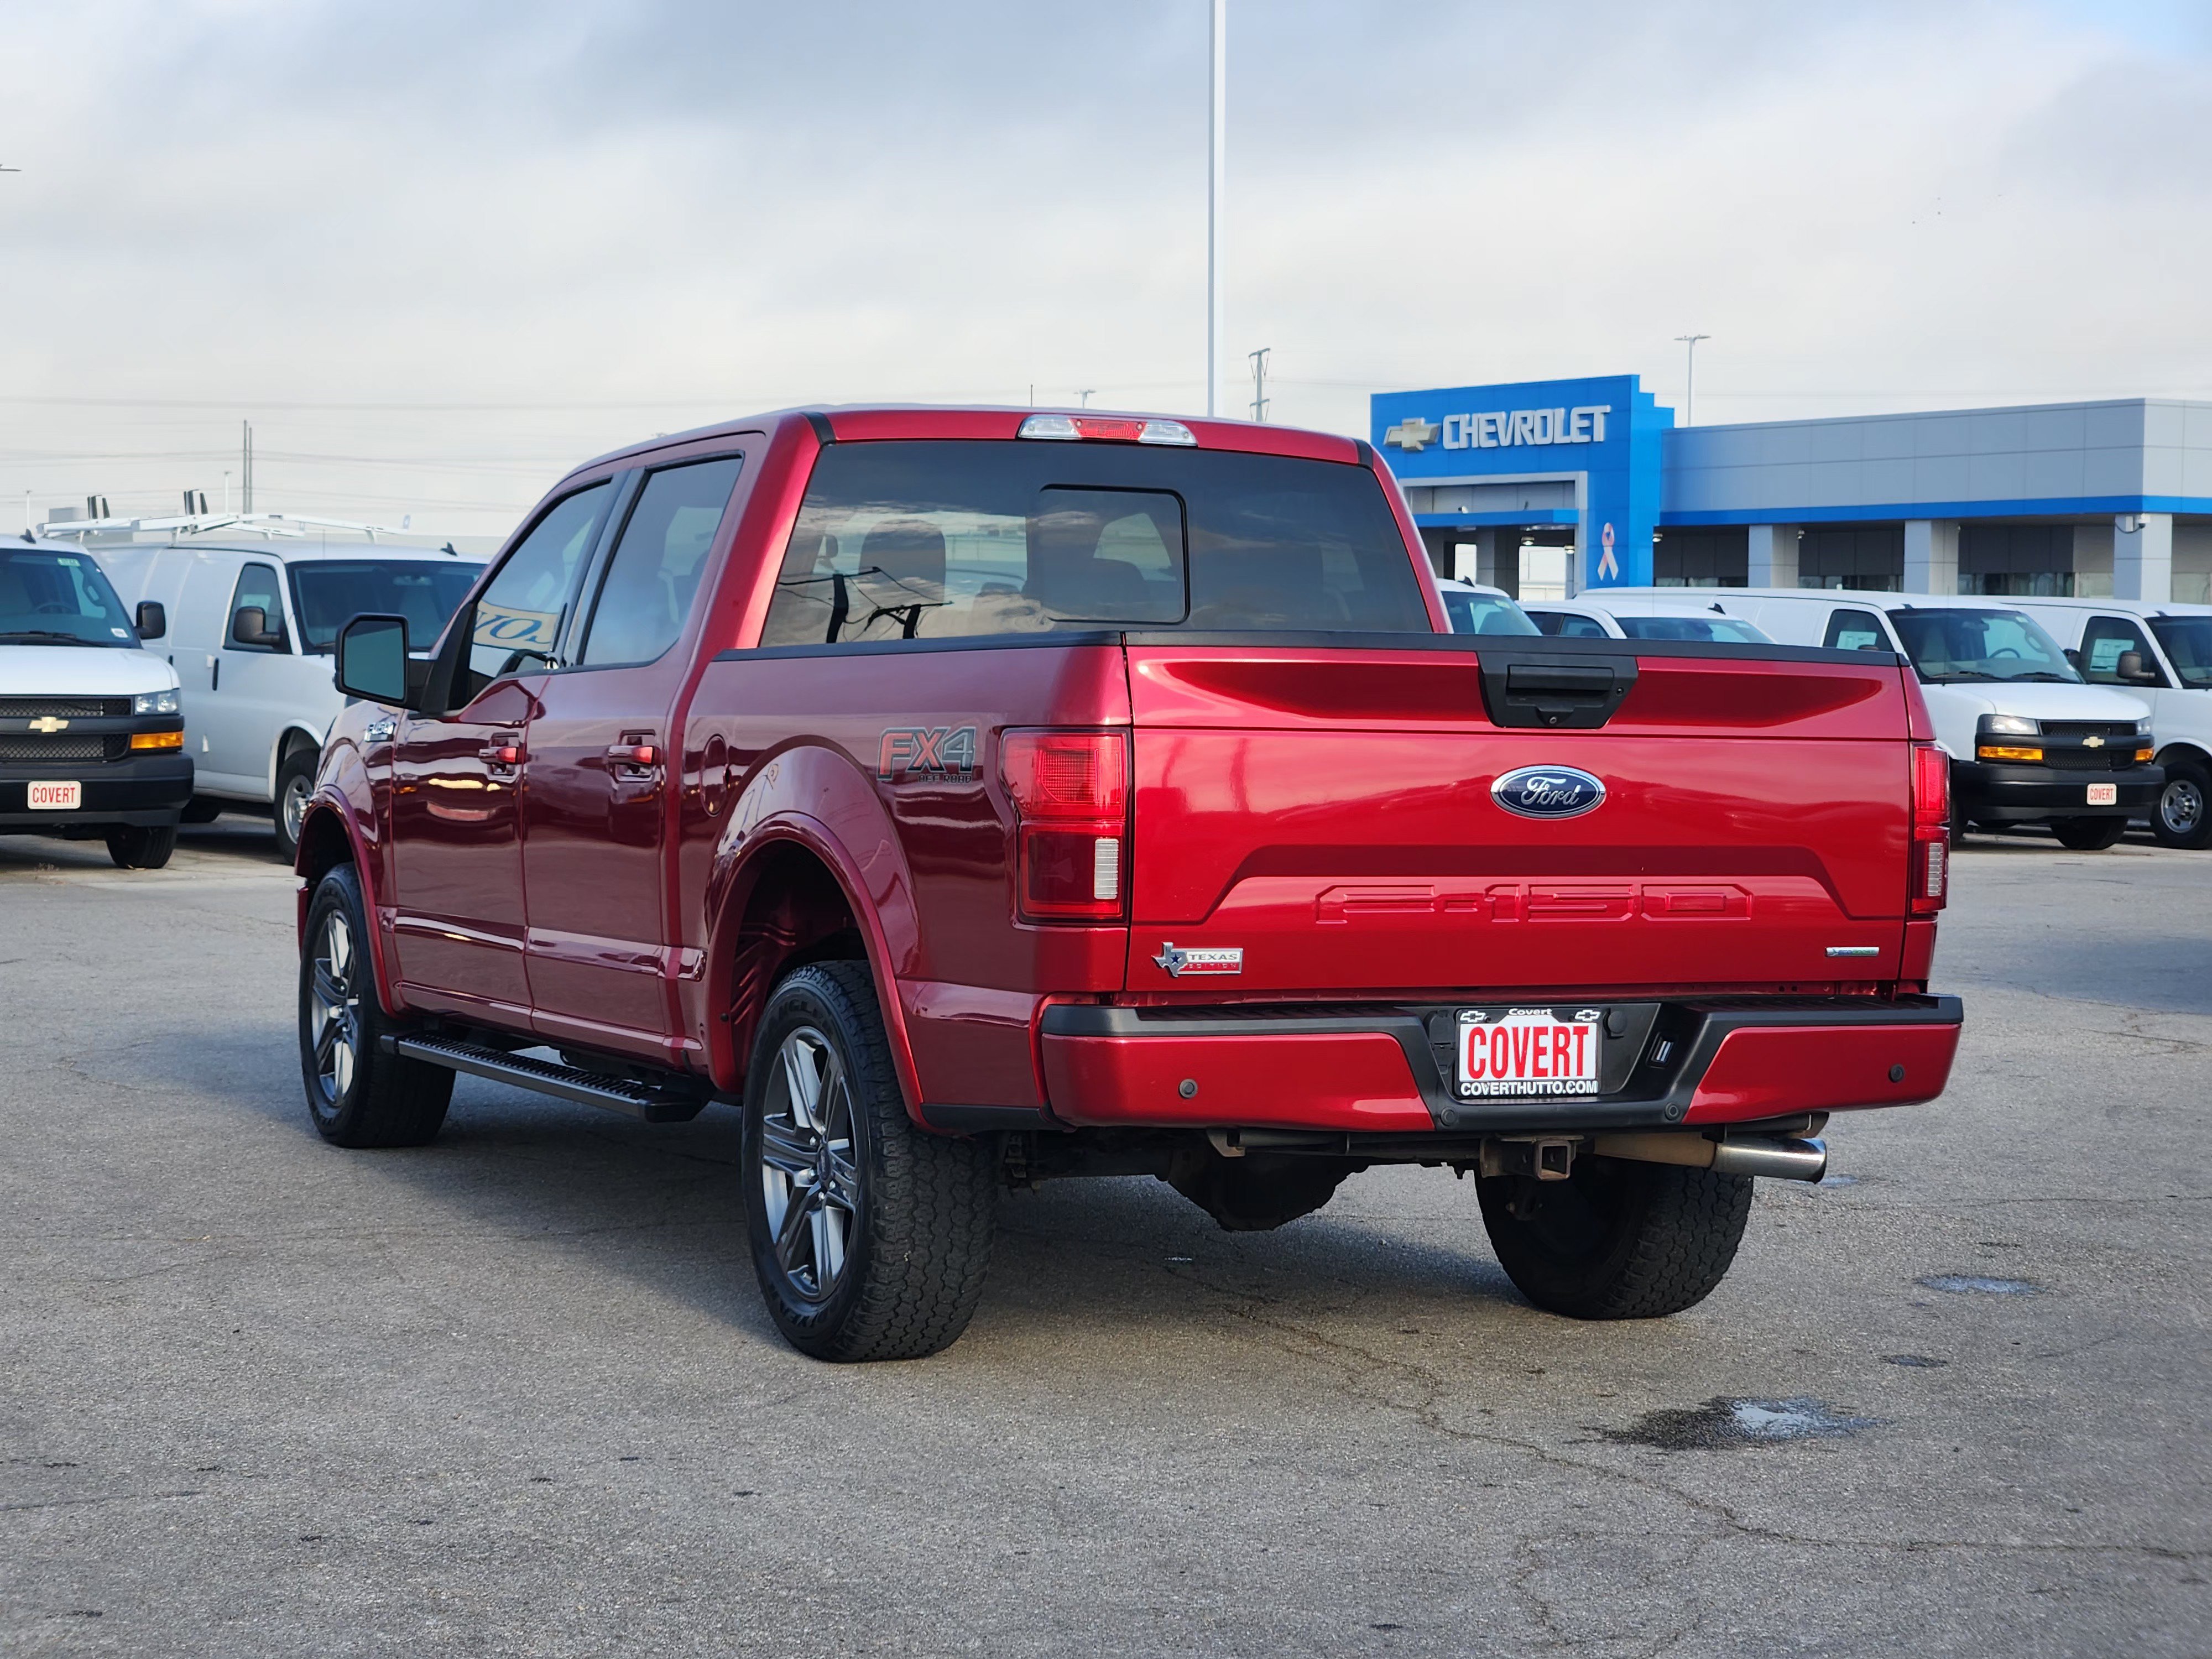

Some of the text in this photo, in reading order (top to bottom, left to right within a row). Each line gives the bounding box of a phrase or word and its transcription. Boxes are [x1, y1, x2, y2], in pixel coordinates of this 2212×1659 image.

[1443, 405, 1611, 449] CHEVROLET
[877, 726, 976, 781] FX4
[943, 775, 972, 783] ROAD
[1521, 776, 1581, 805] Ford
[2090, 787, 2114, 800] COVERT
[33, 787, 75, 803] COVERT
[1316, 884, 1752, 924] F-150
[1467, 1026, 1589, 1079] COVERT
[1460, 1080, 1598, 1096] COVERTHUTTO.COM
